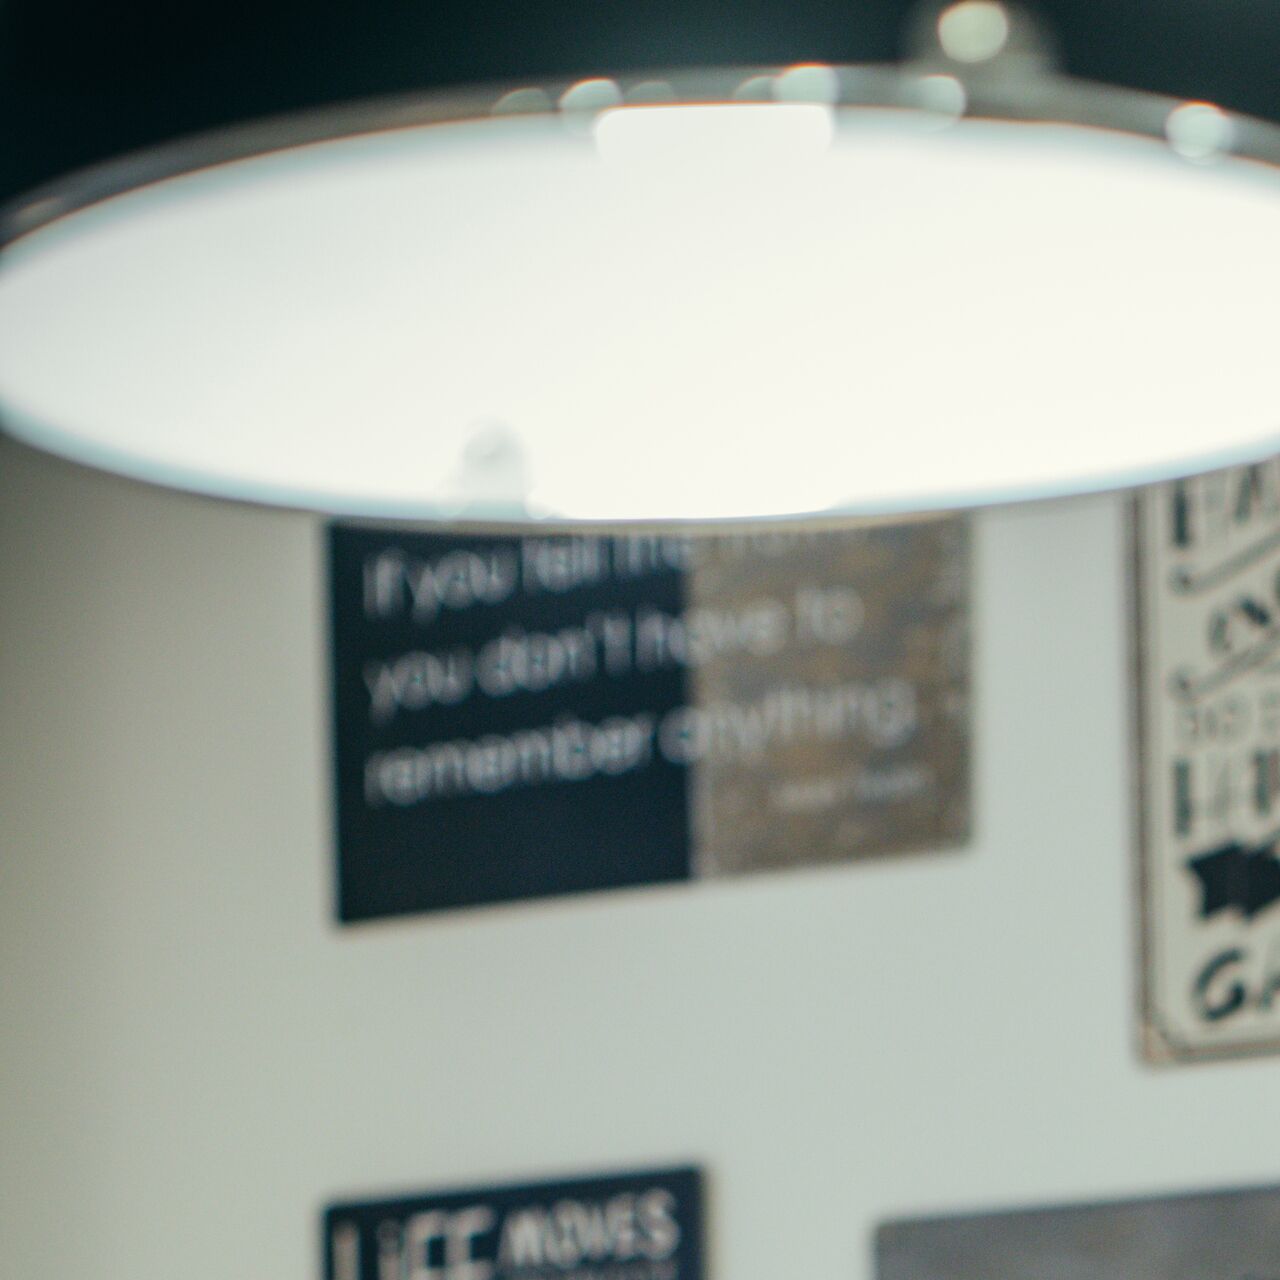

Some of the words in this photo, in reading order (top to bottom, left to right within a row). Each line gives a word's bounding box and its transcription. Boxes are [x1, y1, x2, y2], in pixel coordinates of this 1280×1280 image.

[408, 545, 518, 626] you
[364, 646, 474, 725] you
[363, 708, 653, 808] remember
